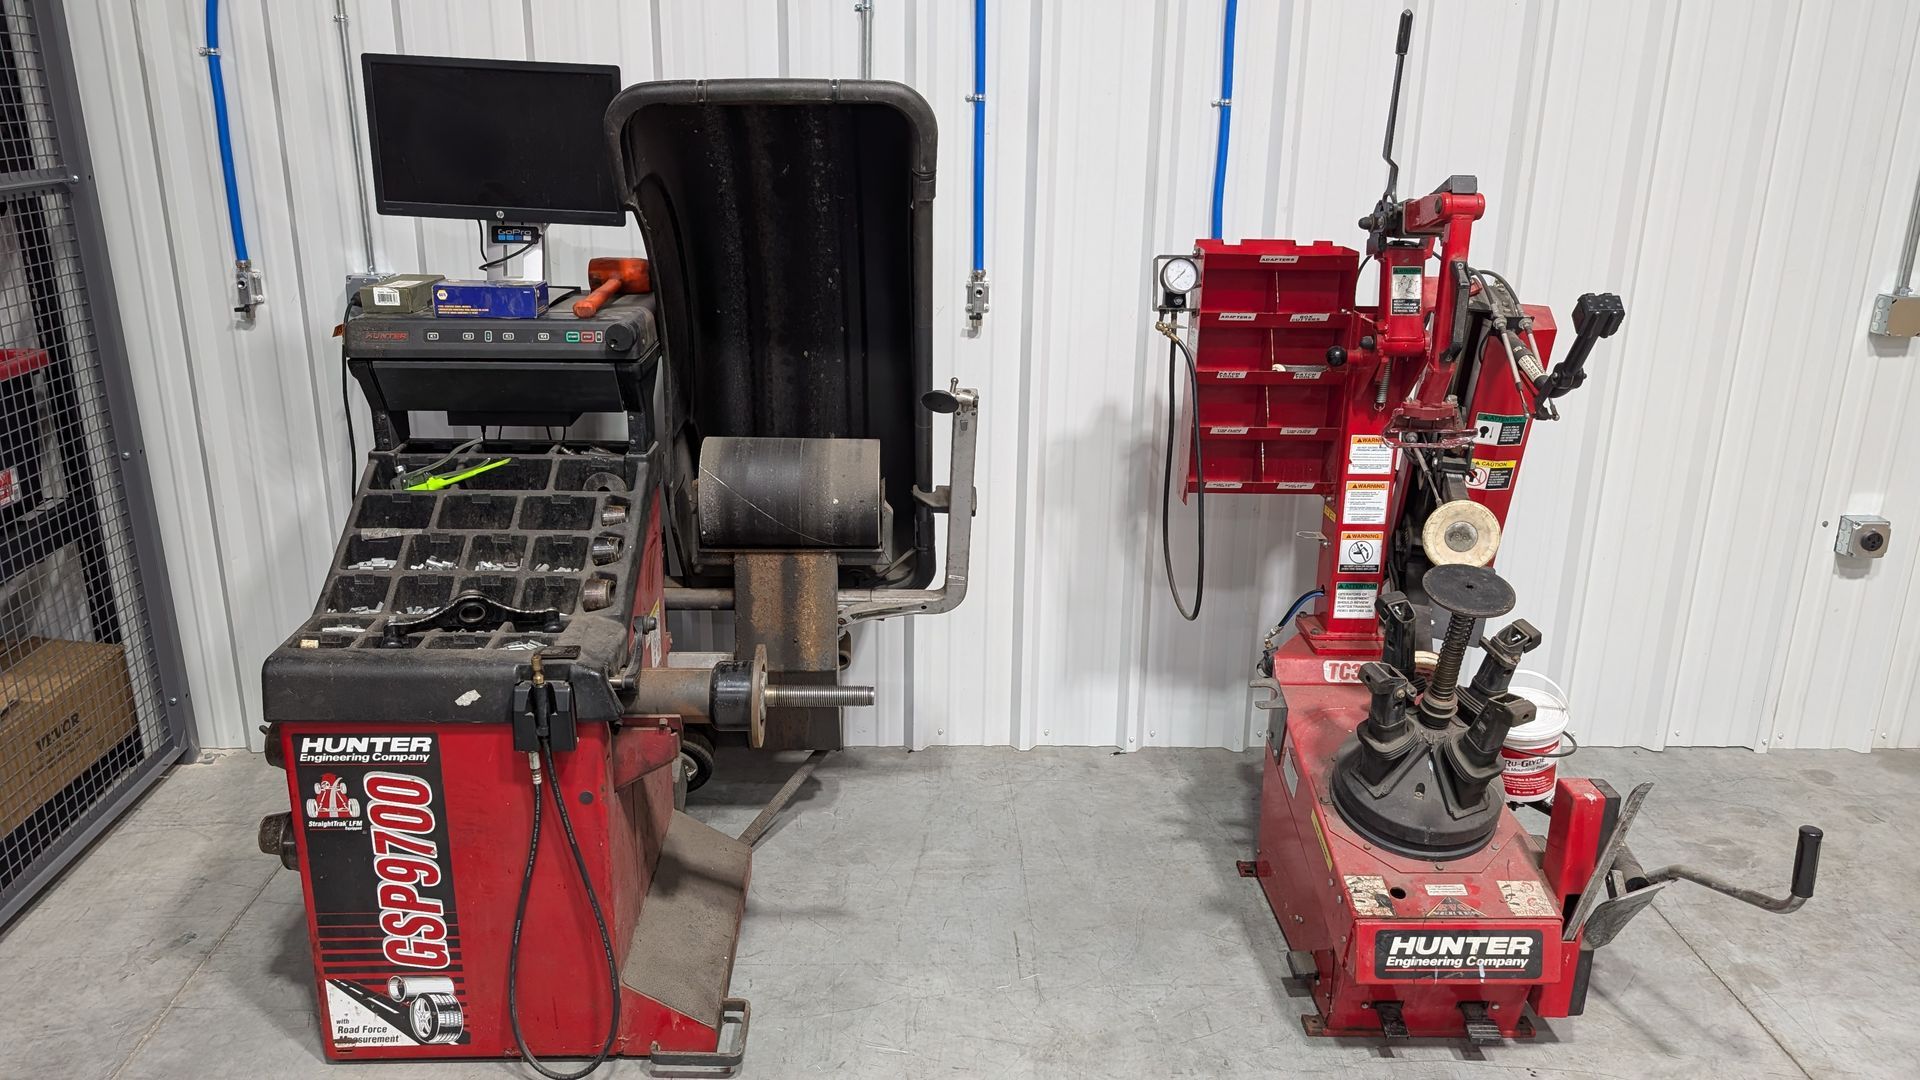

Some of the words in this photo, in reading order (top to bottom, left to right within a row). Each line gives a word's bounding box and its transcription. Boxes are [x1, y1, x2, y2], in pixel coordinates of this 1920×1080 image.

[363, 332, 408, 340] HUNTER
[36, 712, 81, 752] VEVOR
[301, 737, 432, 753] HUNTER
[300, 753, 370, 763] Engineering
[372, 753, 430, 763] Company
[363, 771, 449, 969] GSP9700
[1389, 936, 1534, 955] HUNTER
[1386, 956, 1464, 968] Engineering
[1466, 956, 1529, 968] Company
[337, 1025, 360, 1034] Road
[362, 1025, 388, 1034] Force
